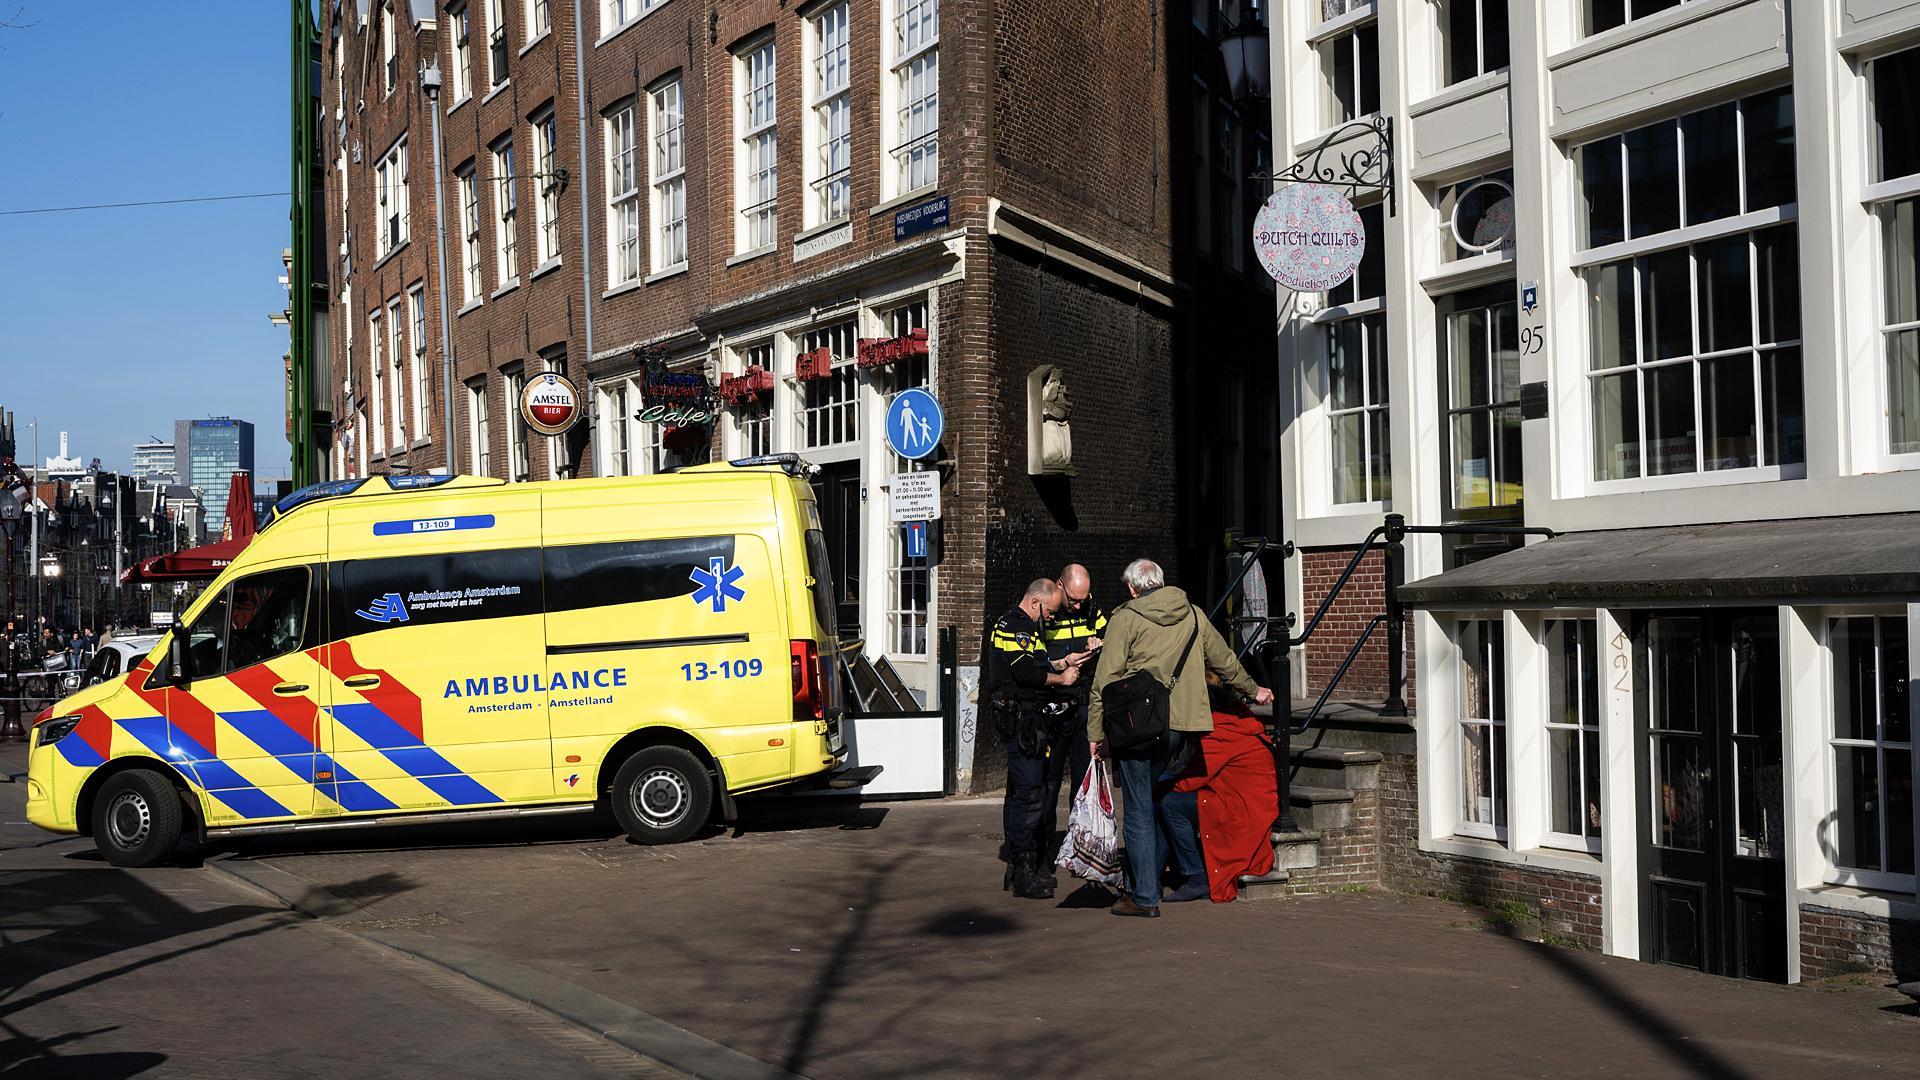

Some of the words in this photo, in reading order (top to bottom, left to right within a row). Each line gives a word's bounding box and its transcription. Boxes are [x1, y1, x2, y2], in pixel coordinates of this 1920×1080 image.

[1260, 231, 1307, 246] DUTCH
[1311, 232, 1359, 246] QUILTS
[1267, 262, 1329, 289] reproduction
[1521, 326, 1543, 356] 95
[532, 395, 571, 404] AMSTEL
[640, 405, 707, 428] Cafe
[418, 520, 450, 530] 13-109
[408, 590, 462, 602] Ambulance
[464, 585, 521, 598] Amsterdam
[410, 602, 425, 610] zorg
[440, 599, 459, 608] hoofd
[468, 598, 483, 606] hart
[680, 657, 763, 682] 13-109
[443, 667, 628, 699] AMBULANCE
[468, 700, 532, 714] Amsterdam
[549, 695, 613, 708] Amstelland
